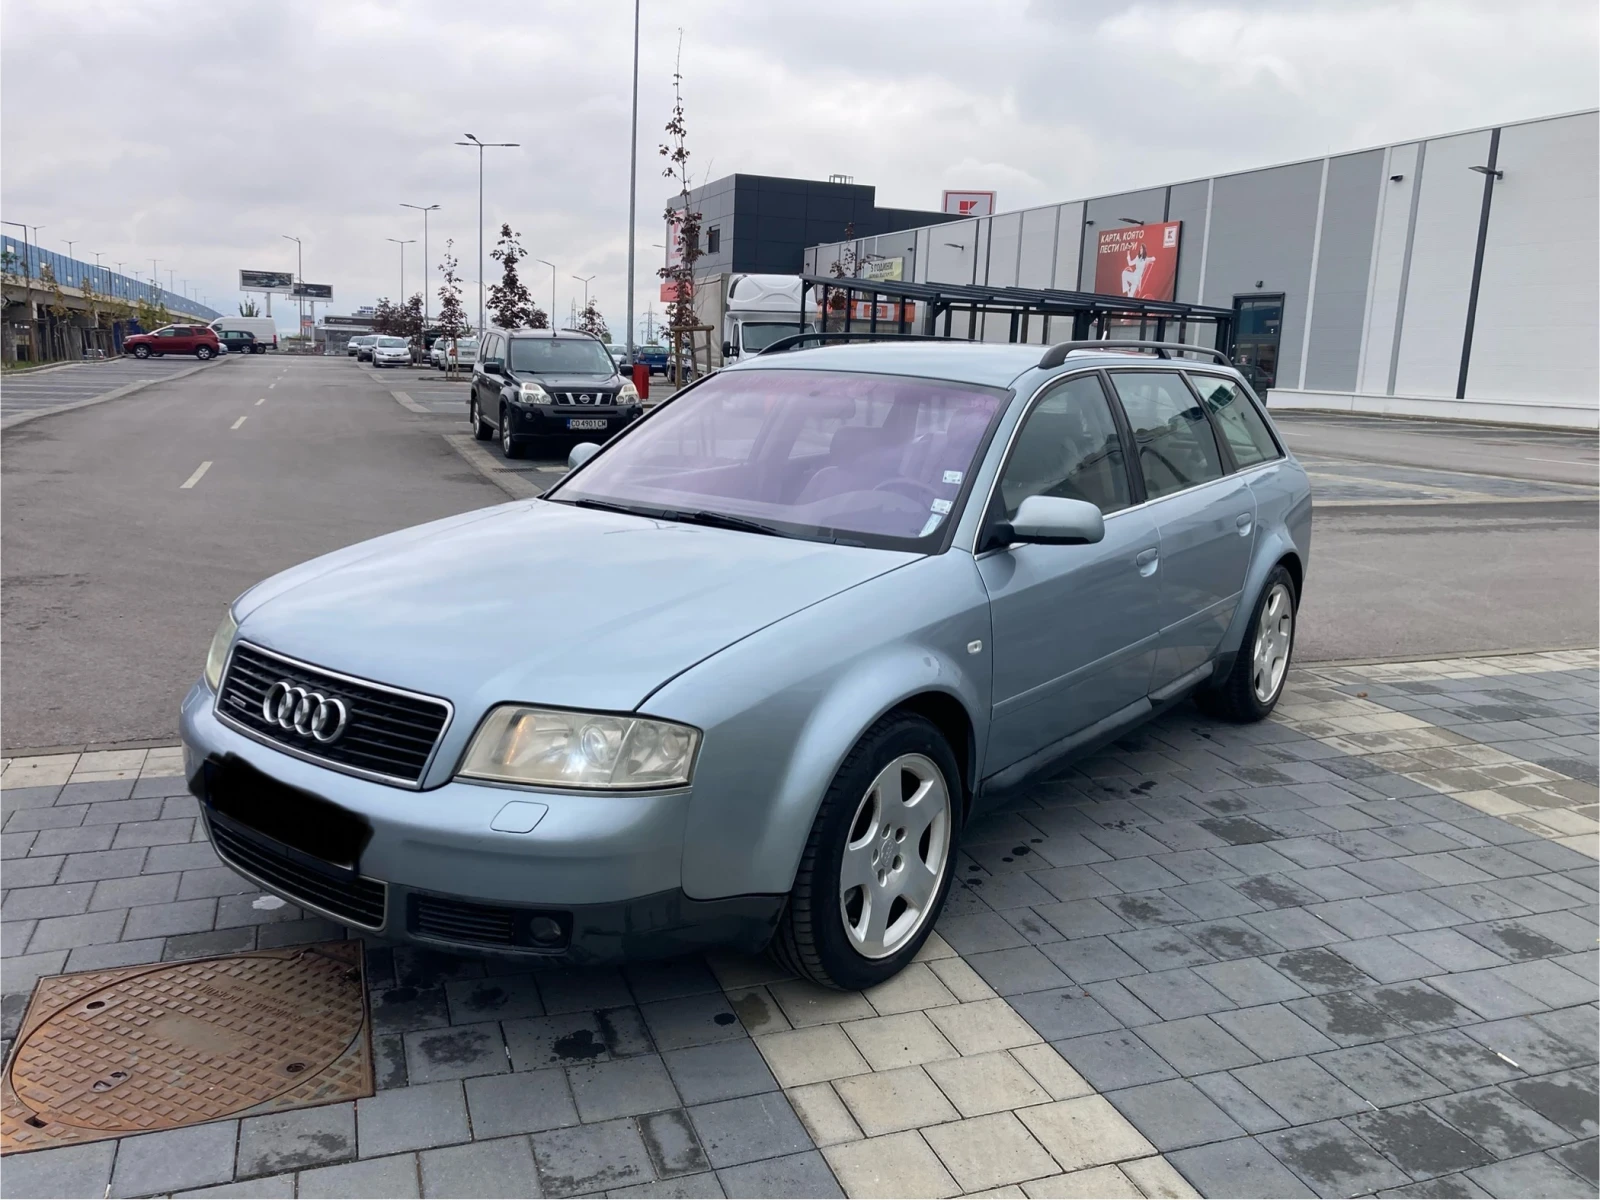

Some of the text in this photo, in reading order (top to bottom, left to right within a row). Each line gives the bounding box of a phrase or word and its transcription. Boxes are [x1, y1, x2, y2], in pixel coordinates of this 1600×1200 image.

[1100, 229, 1145, 244] КАРТА, КОЯТО
[1099, 241, 1138, 254] ПЕСТИ ПАРИ
